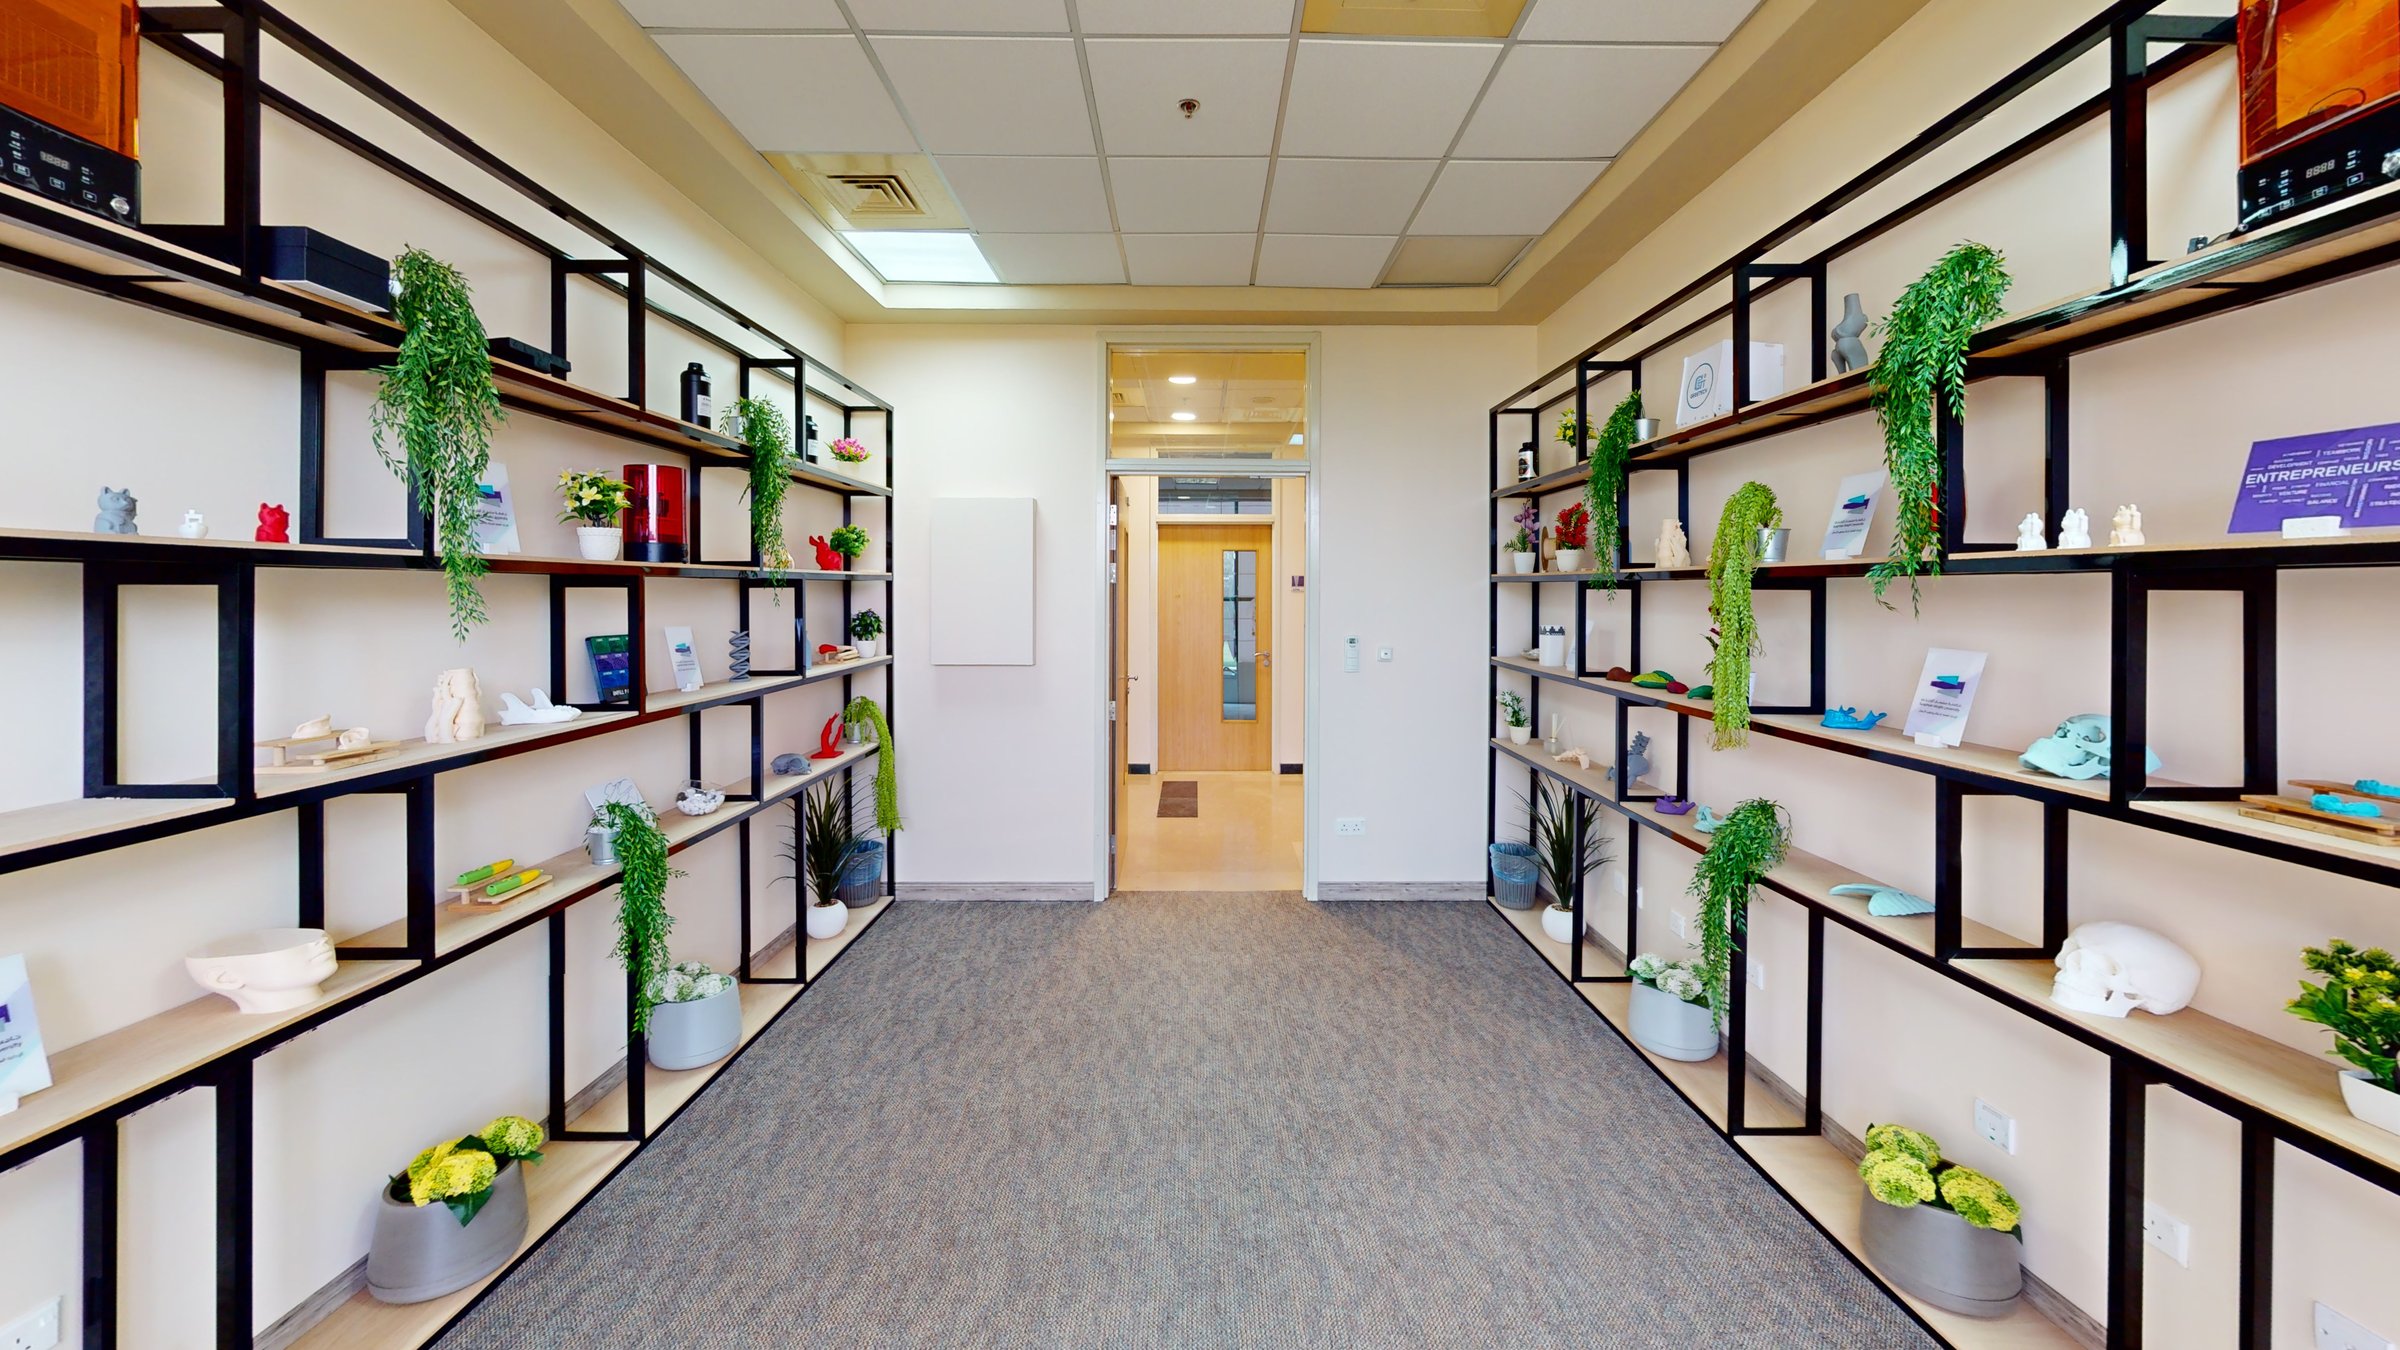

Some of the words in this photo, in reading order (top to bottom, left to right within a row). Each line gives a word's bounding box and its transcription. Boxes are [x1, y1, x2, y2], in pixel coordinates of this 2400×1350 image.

[2267, 460, 2314, 470] DEVELOPMENT
[2245, 459, 2400, 485] ENTREPRENEURS
[2315, 480, 2350, 488] FINANCIAL
